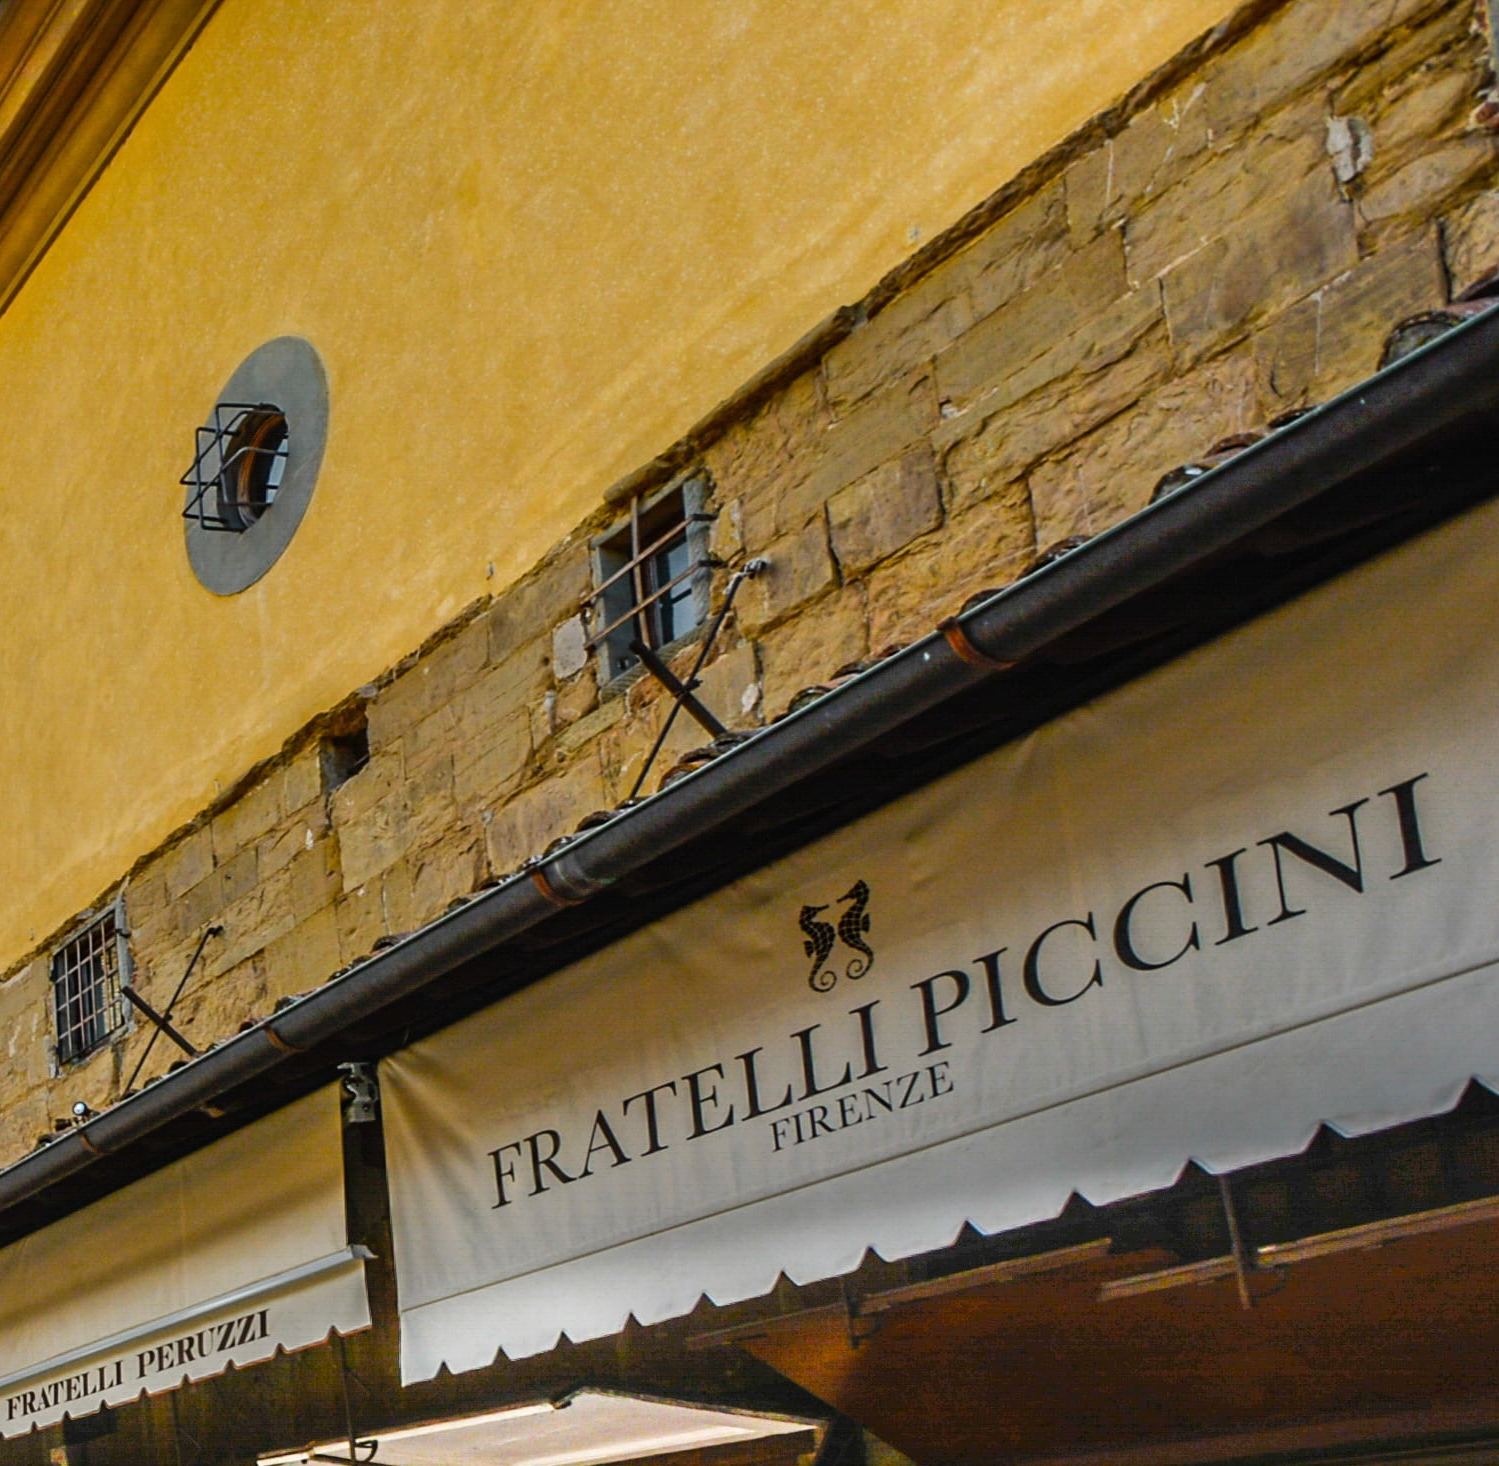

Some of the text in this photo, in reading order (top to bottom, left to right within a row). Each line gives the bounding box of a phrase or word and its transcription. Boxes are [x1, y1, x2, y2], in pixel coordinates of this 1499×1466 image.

[488, 772, 1445, 1211] FRATELLI PICCINI
[768, 1059, 956, 1154] FIRENZE
[5, 1308, 271, 1422] FRATELLI PERUZZI
